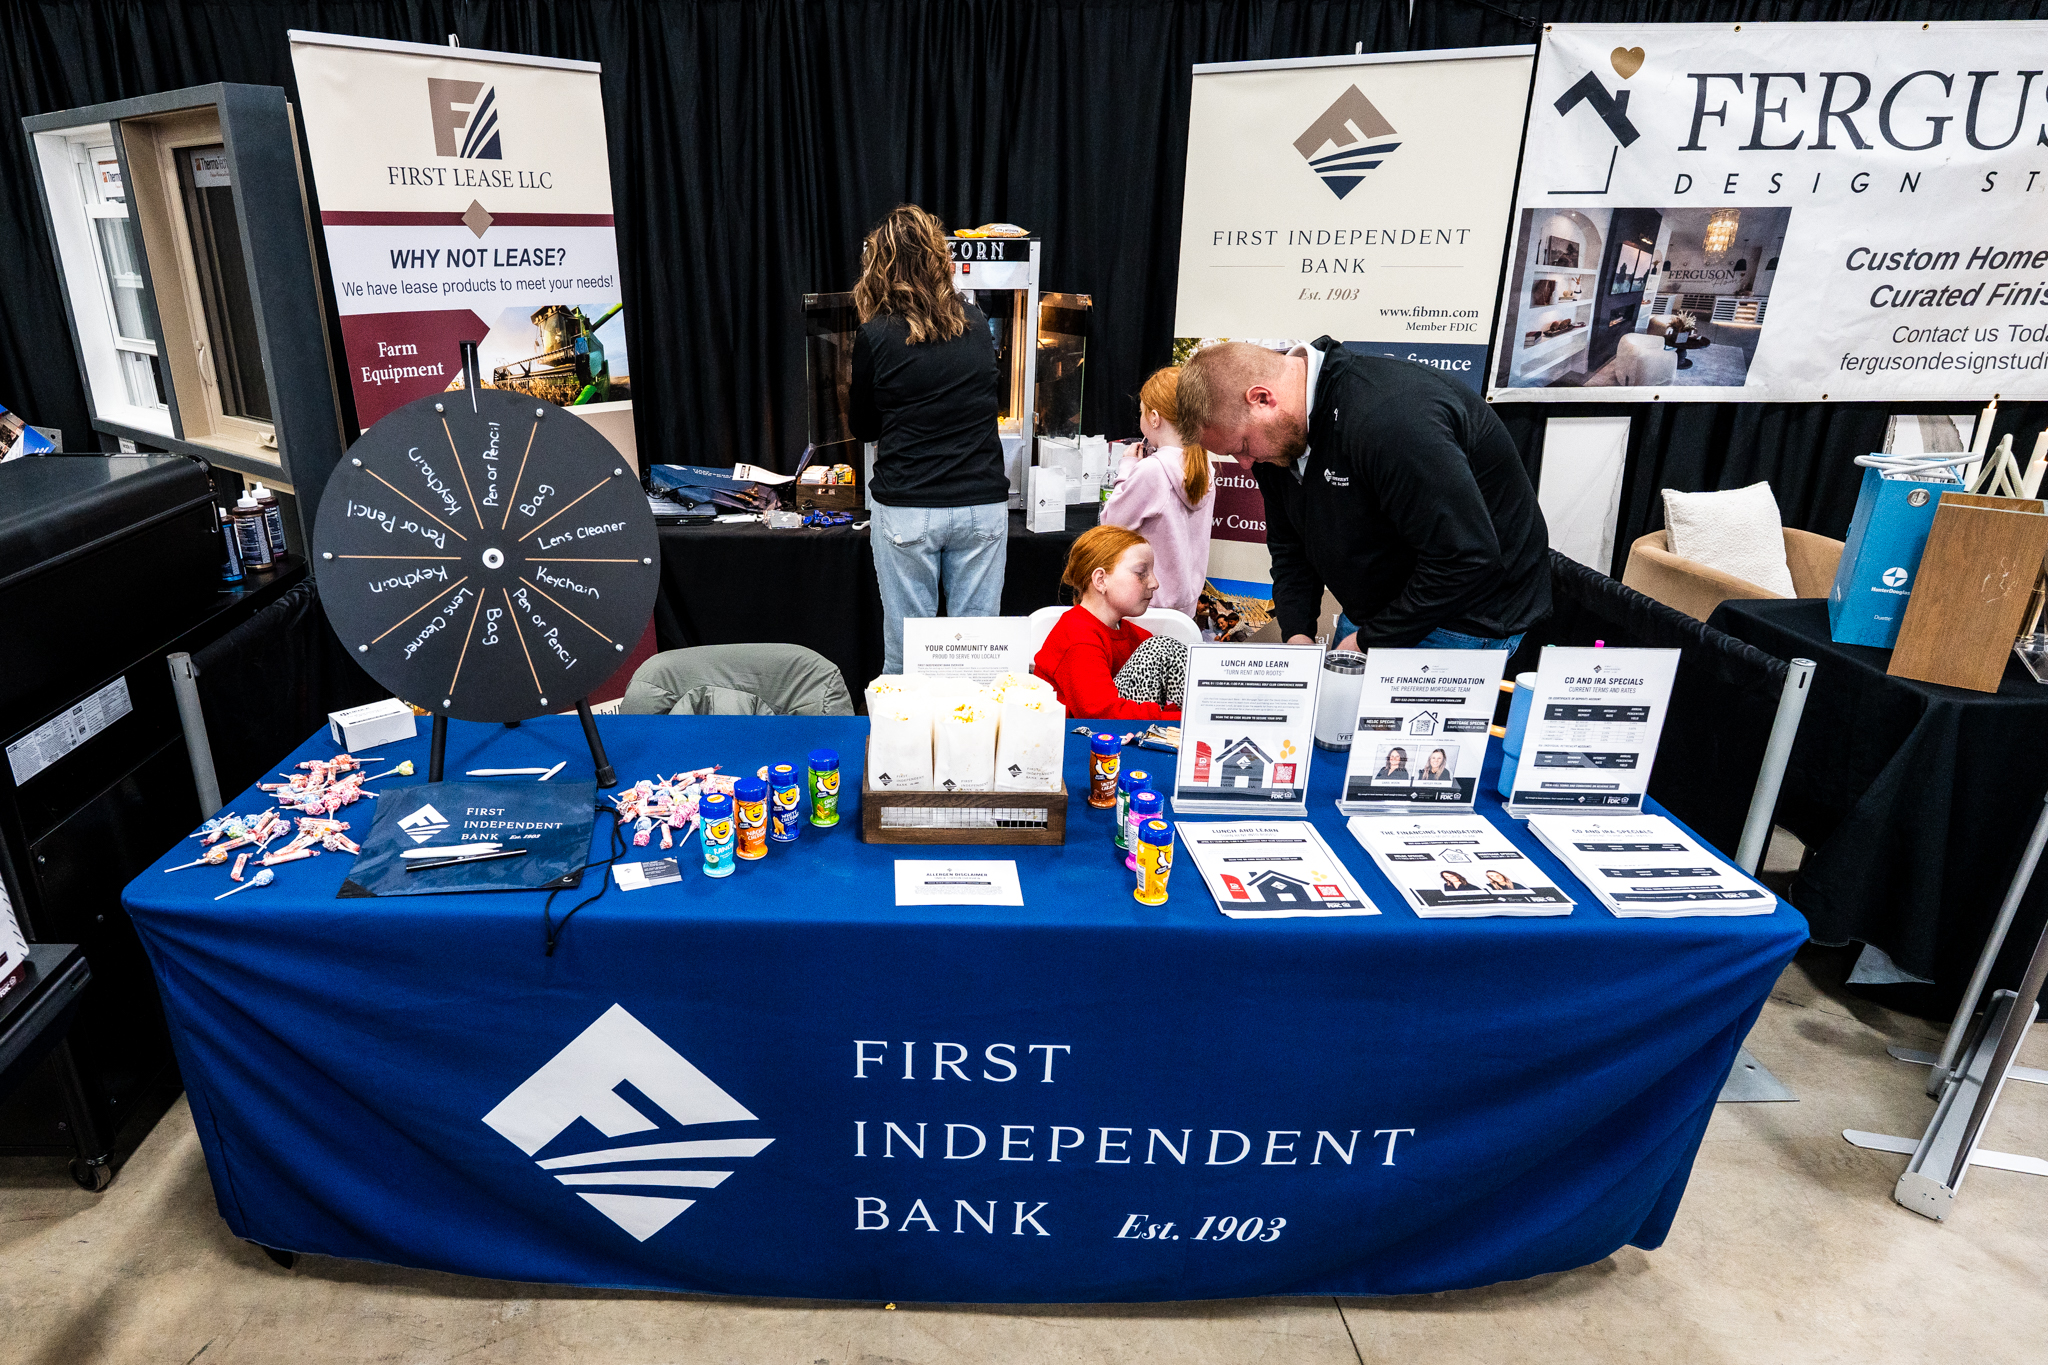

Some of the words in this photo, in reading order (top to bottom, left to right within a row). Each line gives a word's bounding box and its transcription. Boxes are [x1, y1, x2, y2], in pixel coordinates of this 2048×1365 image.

[1677, 70, 2048, 151] FERGU
[387, 166, 447, 186] FIRST
[453, 168, 514, 188] LEASE
[518, 171, 553, 189] LLC
[1674, 172, 1921, 194] DESIGN
[1213, 230, 1278, 246] FIRST
[1288, 228, 1472, 246] INDEPENDENT
[389, 249, 440, 270] WHY
[446, 249, 488, 268] NOT
[493, 248, 566, 267] LEASE?
[1301, 258, 1366, 274] BANK
[1845, 247, 1960, 271] Custom
[1965, 246, 2048, 270] Home
[1668, 269, 1736, 280] FERGUSON
[342, 282, 363, 297] We
[367, 281, 398, 296] have
[401, 279, 438, 295] lease
[442, 278, 497, 296] products
[500, 278, 512, 291] to
[516, 277, 546, 291] meet
[548, 278, 573, 293] your
[576, 275, 614, 289] needs!
[1298, 288, 1321, 301] Est.
[1325, 288, 1360, 301] 1903
[1869, 283, 1986, 308] Curated
[1379, 306, 1479, 319] www.fibmn.com
[1405, 321, 1447, 332] Member
[1449, 322, 1478, 332] FDIC
[1892, 325, 1969, 343] Contact
[1974, 327, 2000, 343] us
[377, 341, 418, 358] Farm
[361, 361, 444, 386] Equipment
[482, 422, 501, 461] Pencil
[408, 447, 462, 516] Keychain
[487, 463, 497, 481] or
[482, 487, 499, 507] Pen
[519, 484, 555, 517] Bag
[347, 500, 396, 533] Pencil
[399, 521, 419, 537] or
[421, 526, 446, 549] Pen
[537, 530, 573, 550] Lens
[576, 521, 627, 540] Cleaner
[369, 566, 448, 593] Keychain
[536, 566, 600, 599] Keychain
[443, 587, 474, 616] Lens
[482, 607, 503, 646] Bag
[512, 587, 530, 614] Pen
[532, 613, 546, 627] or
[543, 628, 578, 670] Pencil
[405, 616, 446, 660] Cleaner
[1265, 660, 1289, 668] LEARN
[1438, 677, 1485, 685] FOUNDATION
[1594, 677, 1607, 685] IRA
[466, 807, 505, 816] FIRST
[463, 820, 563, 830] INDEPENDENT
[460, 833, 499, 841] BANK
[853, 1039, 1071, 1083] FIRST
[853, 1120, 1416, 1167] INDEPENDENT
[854, 1195, 1052, 1237] BANK
[1113, 1212, 1181, 1242] Est.
[1189, 1214, 1288, 1244] 1903
